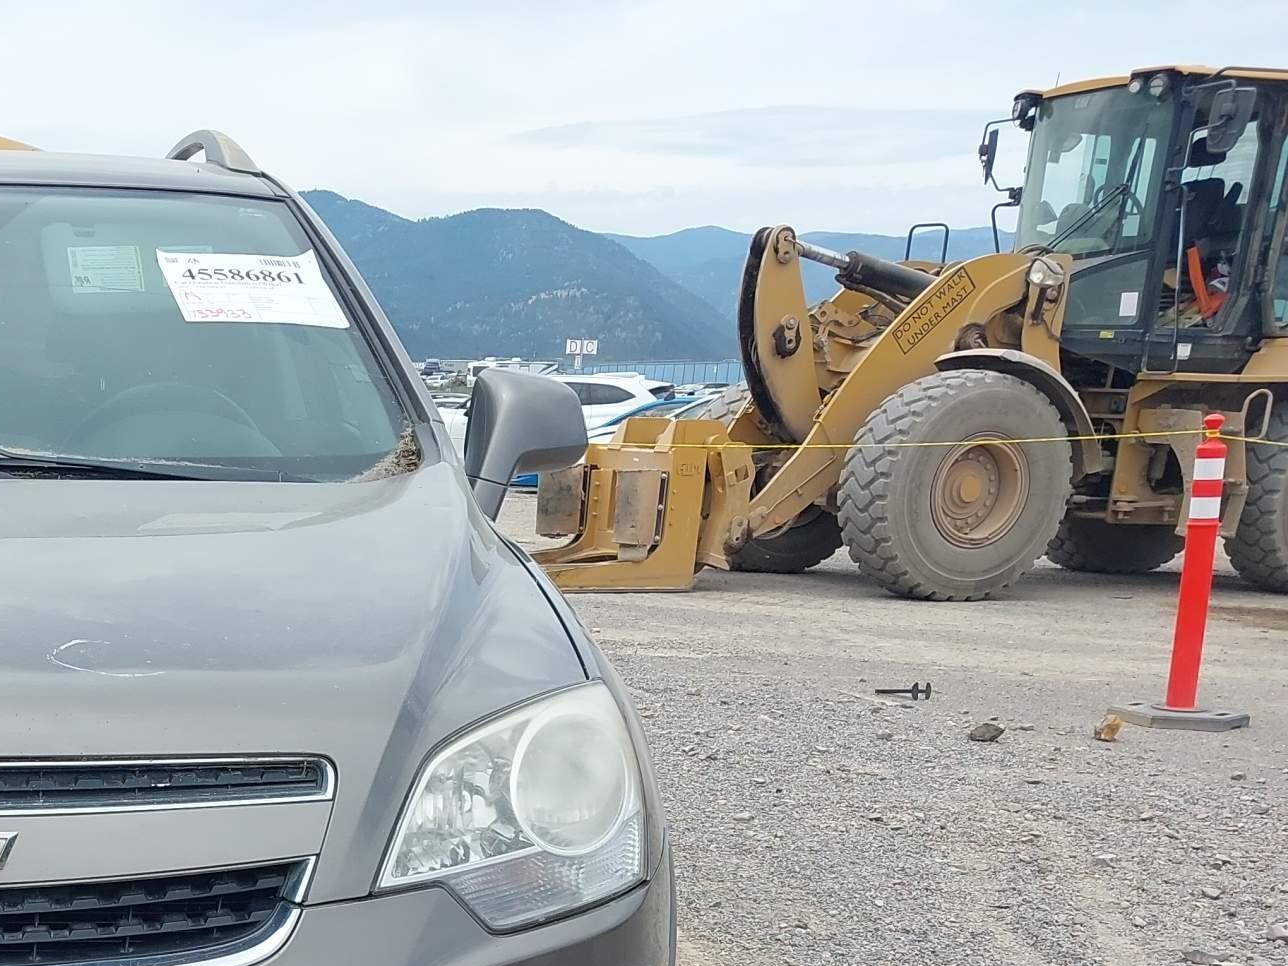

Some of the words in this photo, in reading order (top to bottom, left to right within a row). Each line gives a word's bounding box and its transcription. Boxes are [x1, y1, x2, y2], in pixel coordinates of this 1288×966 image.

[182, 268, 304, 285] 45586861
[894, 322, 912, 340] DO
[912, 300, 935, 324] NOT
[935, 271, 967, 300] WALK
[907, 311, 942, 346] UNDER
[942, 284, 969, 314] MAST
[569, 340, 578, 353] D
[585, 341, 594, 353] C
